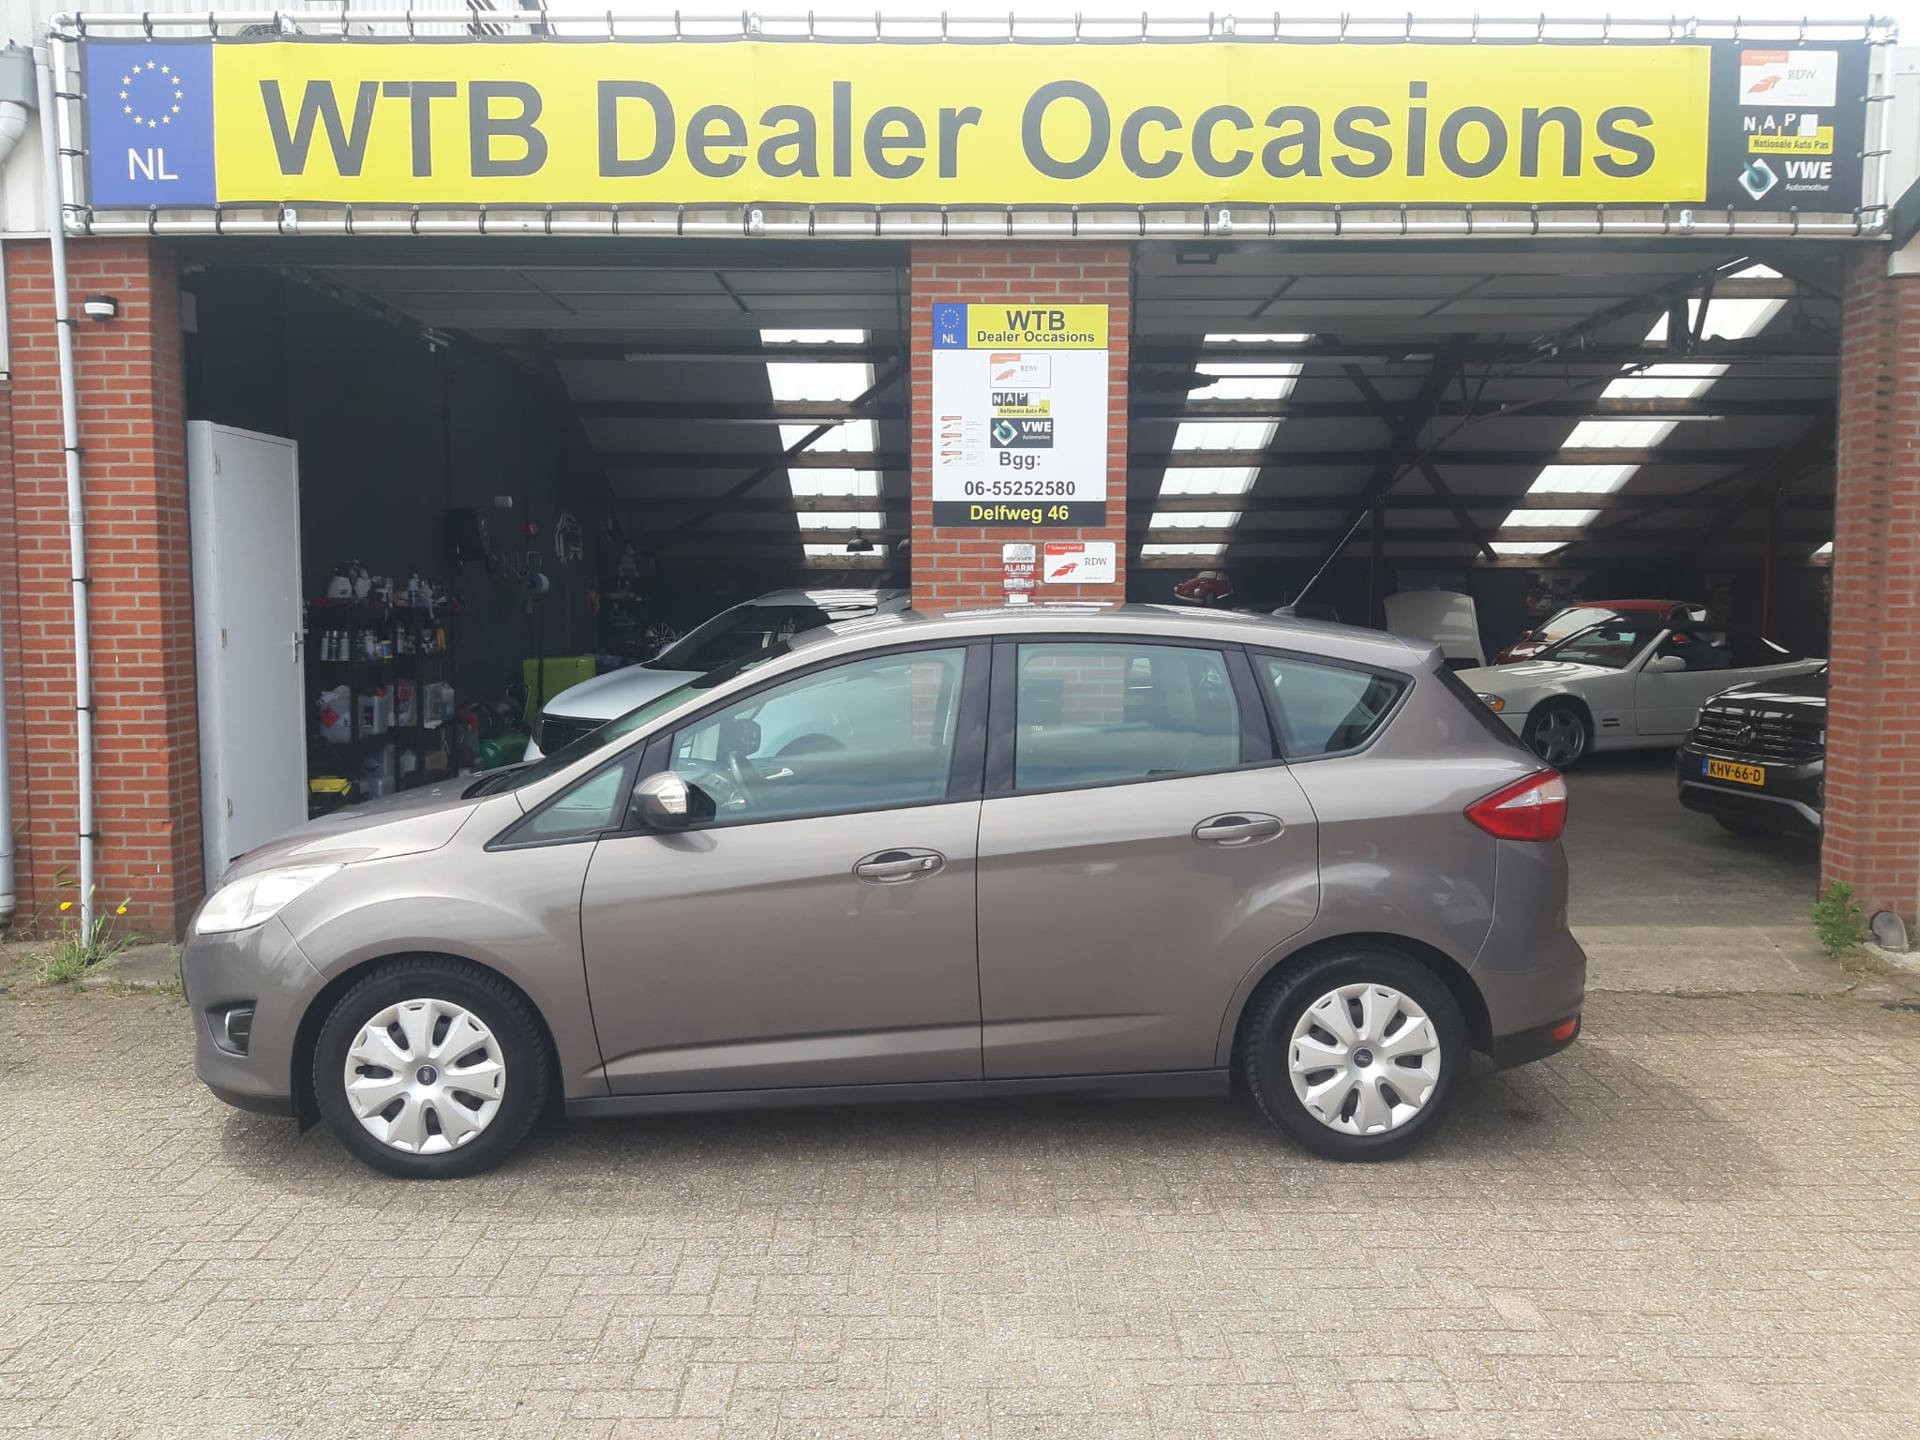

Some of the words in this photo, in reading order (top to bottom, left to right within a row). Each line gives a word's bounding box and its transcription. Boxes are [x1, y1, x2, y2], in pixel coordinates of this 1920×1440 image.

[1787, 68, 1817, 80] RDW
[258, 80, 549, 178] WTB
[597, 80, 983, 180] Dealer
[1021, 80, 1656, 180] Occasions
[1753, 138, 1792, 149] Nationale
[1793, 139, 1812, 149] Auto
[1814, 140, 1829, 149] Pas
[128, 147, 179, 181] NL
[1784, 160, 1833, 180] VWE
[1785, 183, 1830, 192] Automotive
[1005, 310, 1066, 331] WTB
[942, 333, 958, 344] NL
[977, 330, 1021, 342] Dealer
[1023, 330, 1095, 343] Occasions
[1021, 421, 1052, 433] VWE
[999, 451, 1041, 471] Bgg:
[964, 480, 1076, 496] 06-55252580
[970, 504, 1043, 524] Delfweg
[1047, 504, 1069, 521] 46
[1004, 563, 1035, 573] ALARM
[1084, 557, 1108, 567] RDW
[1709, 761, 1761, 782] KHV-66-D
